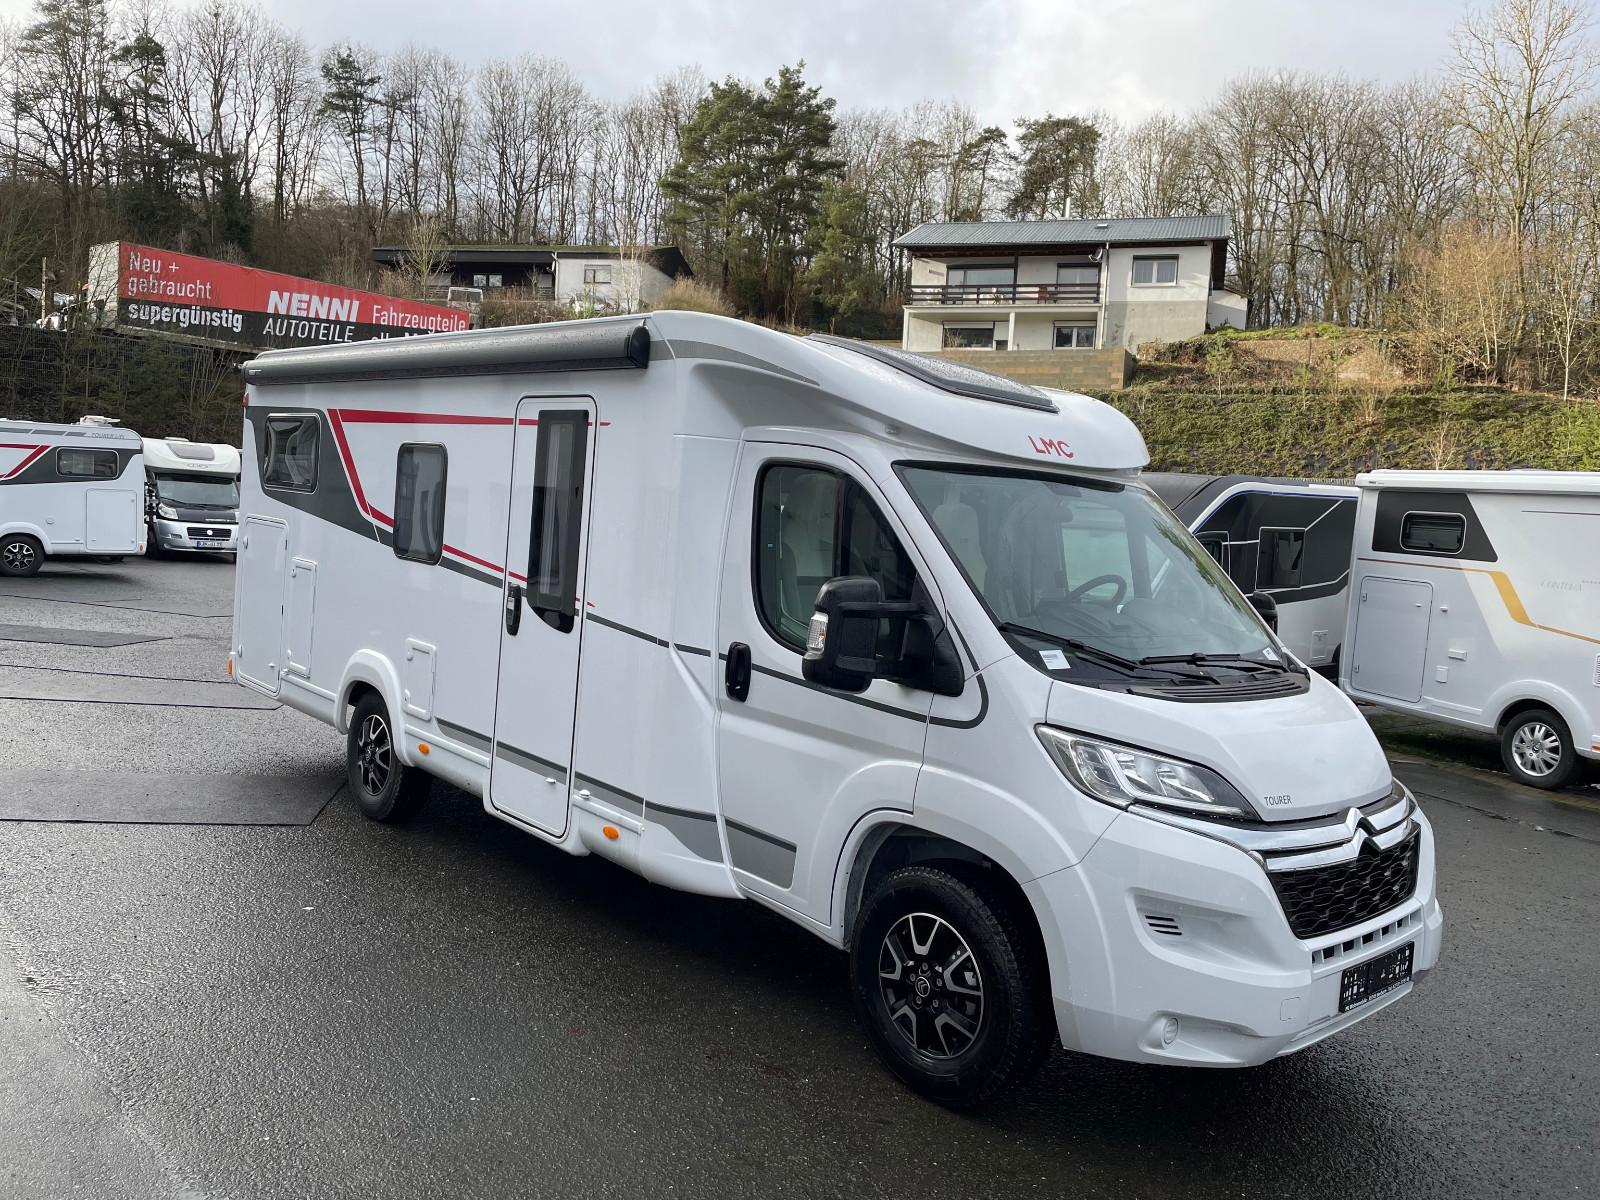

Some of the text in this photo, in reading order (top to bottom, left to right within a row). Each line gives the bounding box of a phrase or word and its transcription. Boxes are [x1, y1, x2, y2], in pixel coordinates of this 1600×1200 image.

[129, 251, 180, 274] Neu +
[128, 274, 212, 299] gebraucht
[128, 303, 243, 333] supergünstig
[266, 289, 360, 322] NENNI
[262, 317, 355, 343] AUTOTEILE
[372, 304, 466, 334] Fahrzeugteile
[1027, 434, 1074, 458] LMC
[1263, 794, 1293, 806] TOURER
